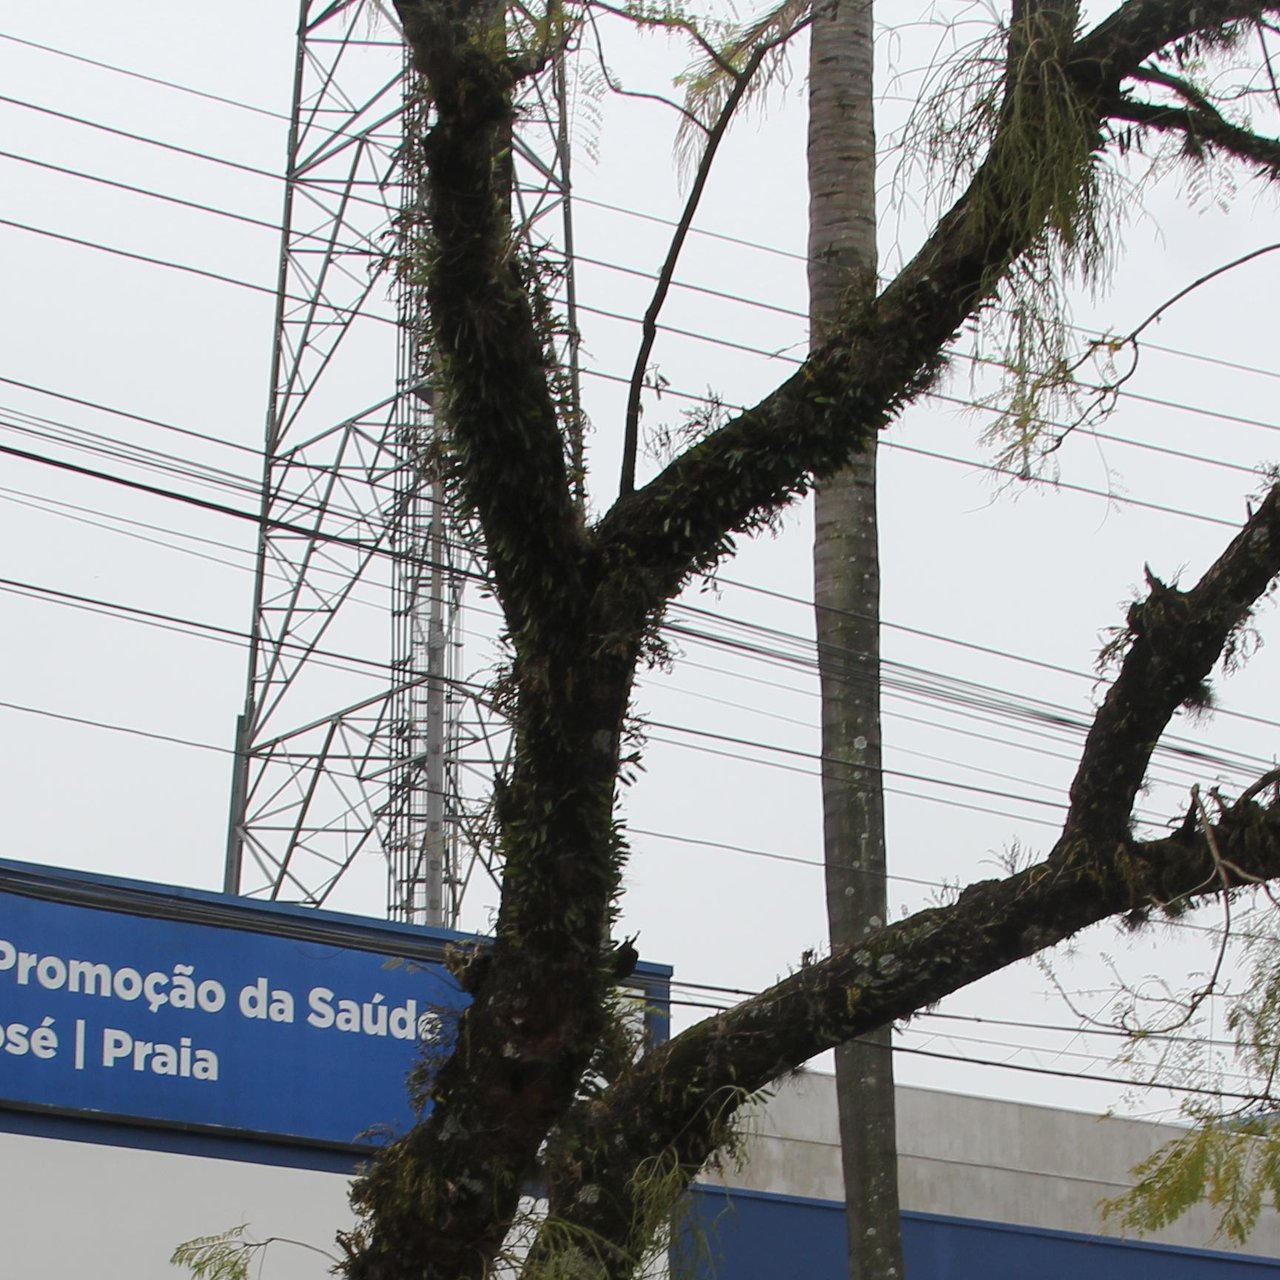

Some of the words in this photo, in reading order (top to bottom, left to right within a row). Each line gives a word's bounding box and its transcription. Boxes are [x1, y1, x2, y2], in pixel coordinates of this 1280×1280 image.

[238, 977, 295, 1023] da
[307, 988, 444, 1043] Saúde
[102, 1028, 219, 1081] Praia
